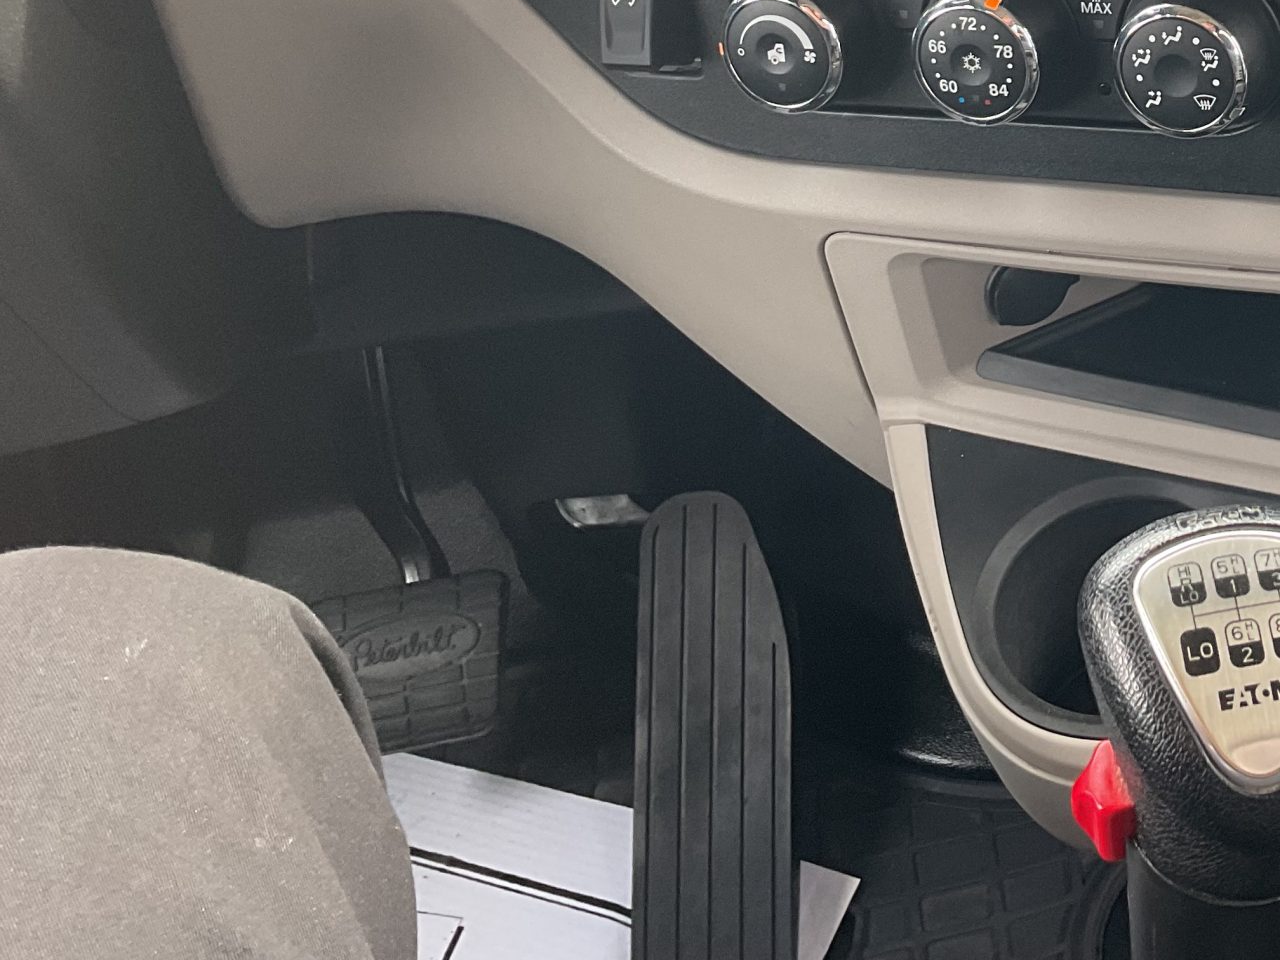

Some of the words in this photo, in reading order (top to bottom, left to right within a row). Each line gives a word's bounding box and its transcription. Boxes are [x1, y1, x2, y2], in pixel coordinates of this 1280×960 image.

[1080, 1, 1112, 15] MAX
[958, 17, 977, 32] 72
[928, 40, 947, 54] 66
[993, 45, 1013, 59] 78
[939, 79, 958, 94] 60
[988, 83, 1009, 97] 84
[1216, 560, 1229, 574] 5
[1260, 553, 1270, 567] 7
[1177, 566, 1191, 578] HI
[1230, 578, 1237, 593] 1
[1180, 591, 1199, 604] LO
[1231, 626, 1244, 641] 6
[1187, 642, 1214, 662] LO
[1241, 647, 1254, 663] 2
